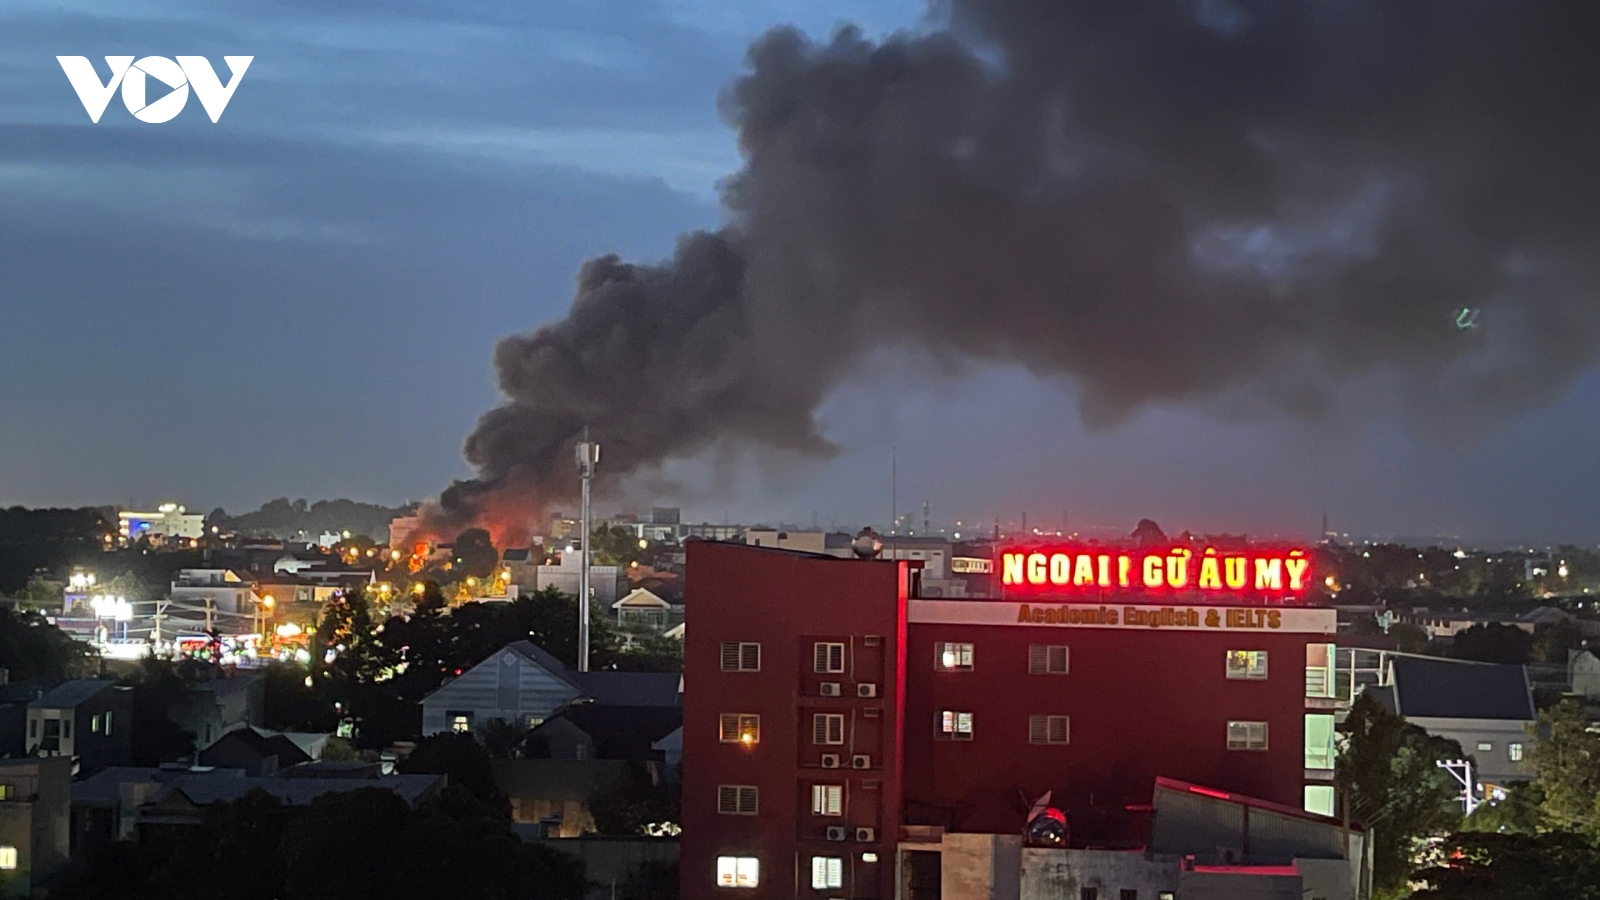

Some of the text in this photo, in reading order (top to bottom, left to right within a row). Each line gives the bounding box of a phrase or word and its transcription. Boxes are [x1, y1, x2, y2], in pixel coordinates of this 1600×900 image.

[1198, 547, 1247, 589] ÂU
[1254, 550, 1308, 590] MỸ
[1017, 604, 1282, 629] Academic English & IELTS
